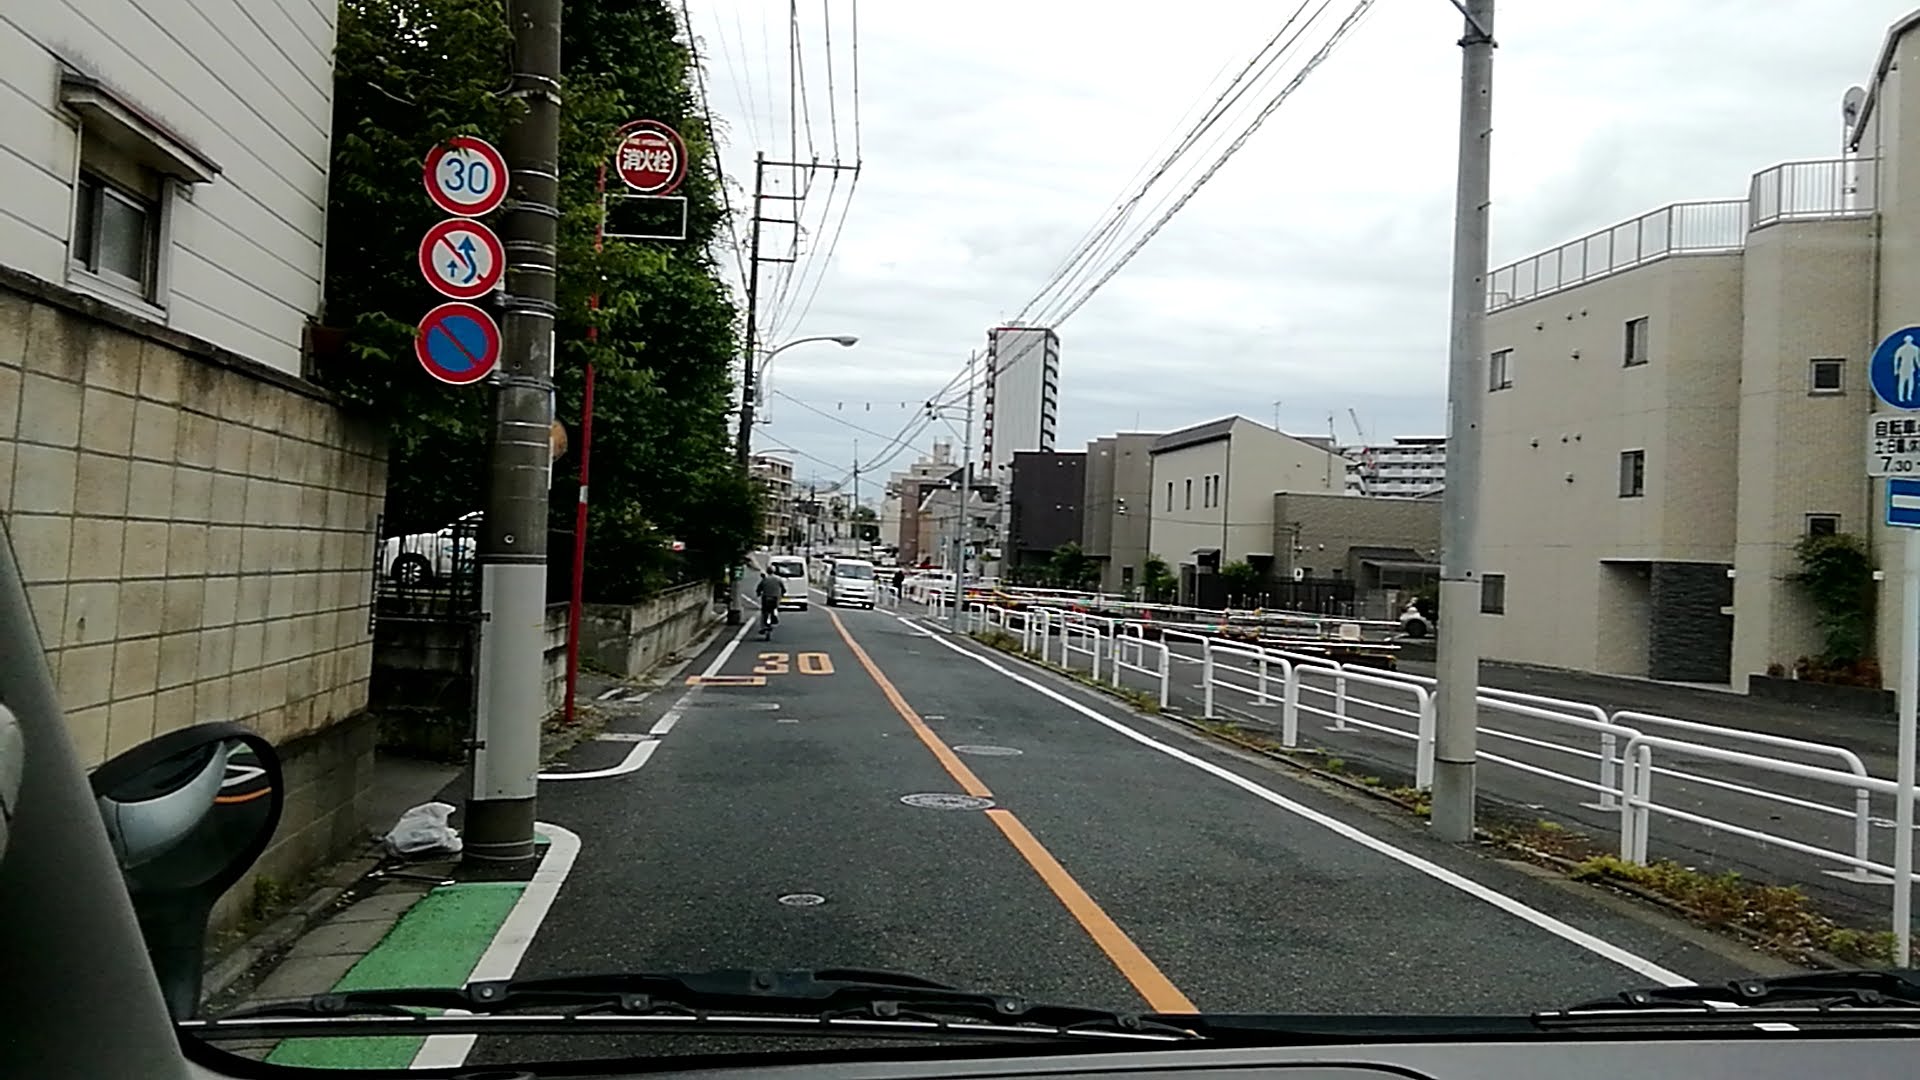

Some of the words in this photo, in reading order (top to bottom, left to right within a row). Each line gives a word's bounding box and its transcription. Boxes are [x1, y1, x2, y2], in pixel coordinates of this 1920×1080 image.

[623, 148, 672, 173] 消火栓
[445, 157, 488, 194] 30
[1876, 420, 1920, 436] 自転車
[753, 652, 835, 675] 30
